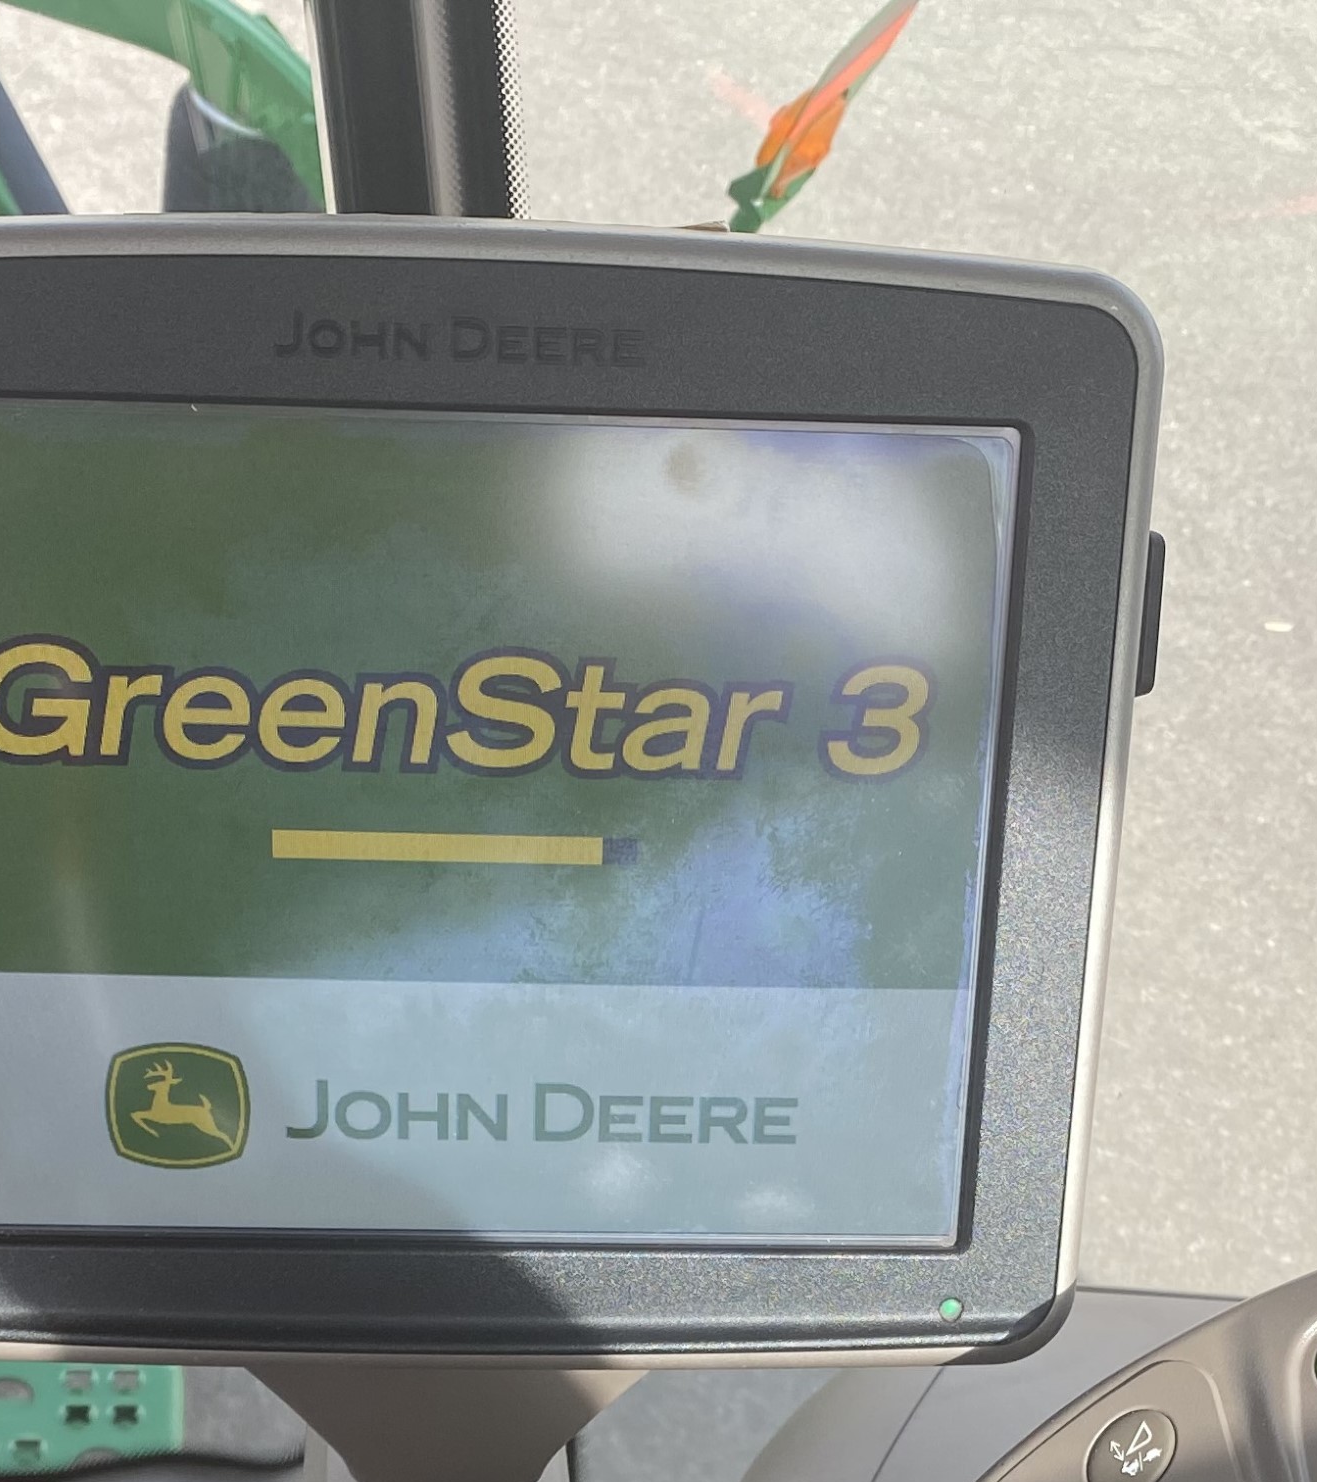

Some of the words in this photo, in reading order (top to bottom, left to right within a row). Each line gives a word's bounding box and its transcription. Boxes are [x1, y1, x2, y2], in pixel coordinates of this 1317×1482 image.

[274, 310, 433, 362] JOHN
[450, 315, 647, 368] DEERE
[819, 656, 938, 783] 3
[286, 1079, 508, 1142] JOHN
[533, 1082, 799, 1145] DEERE
